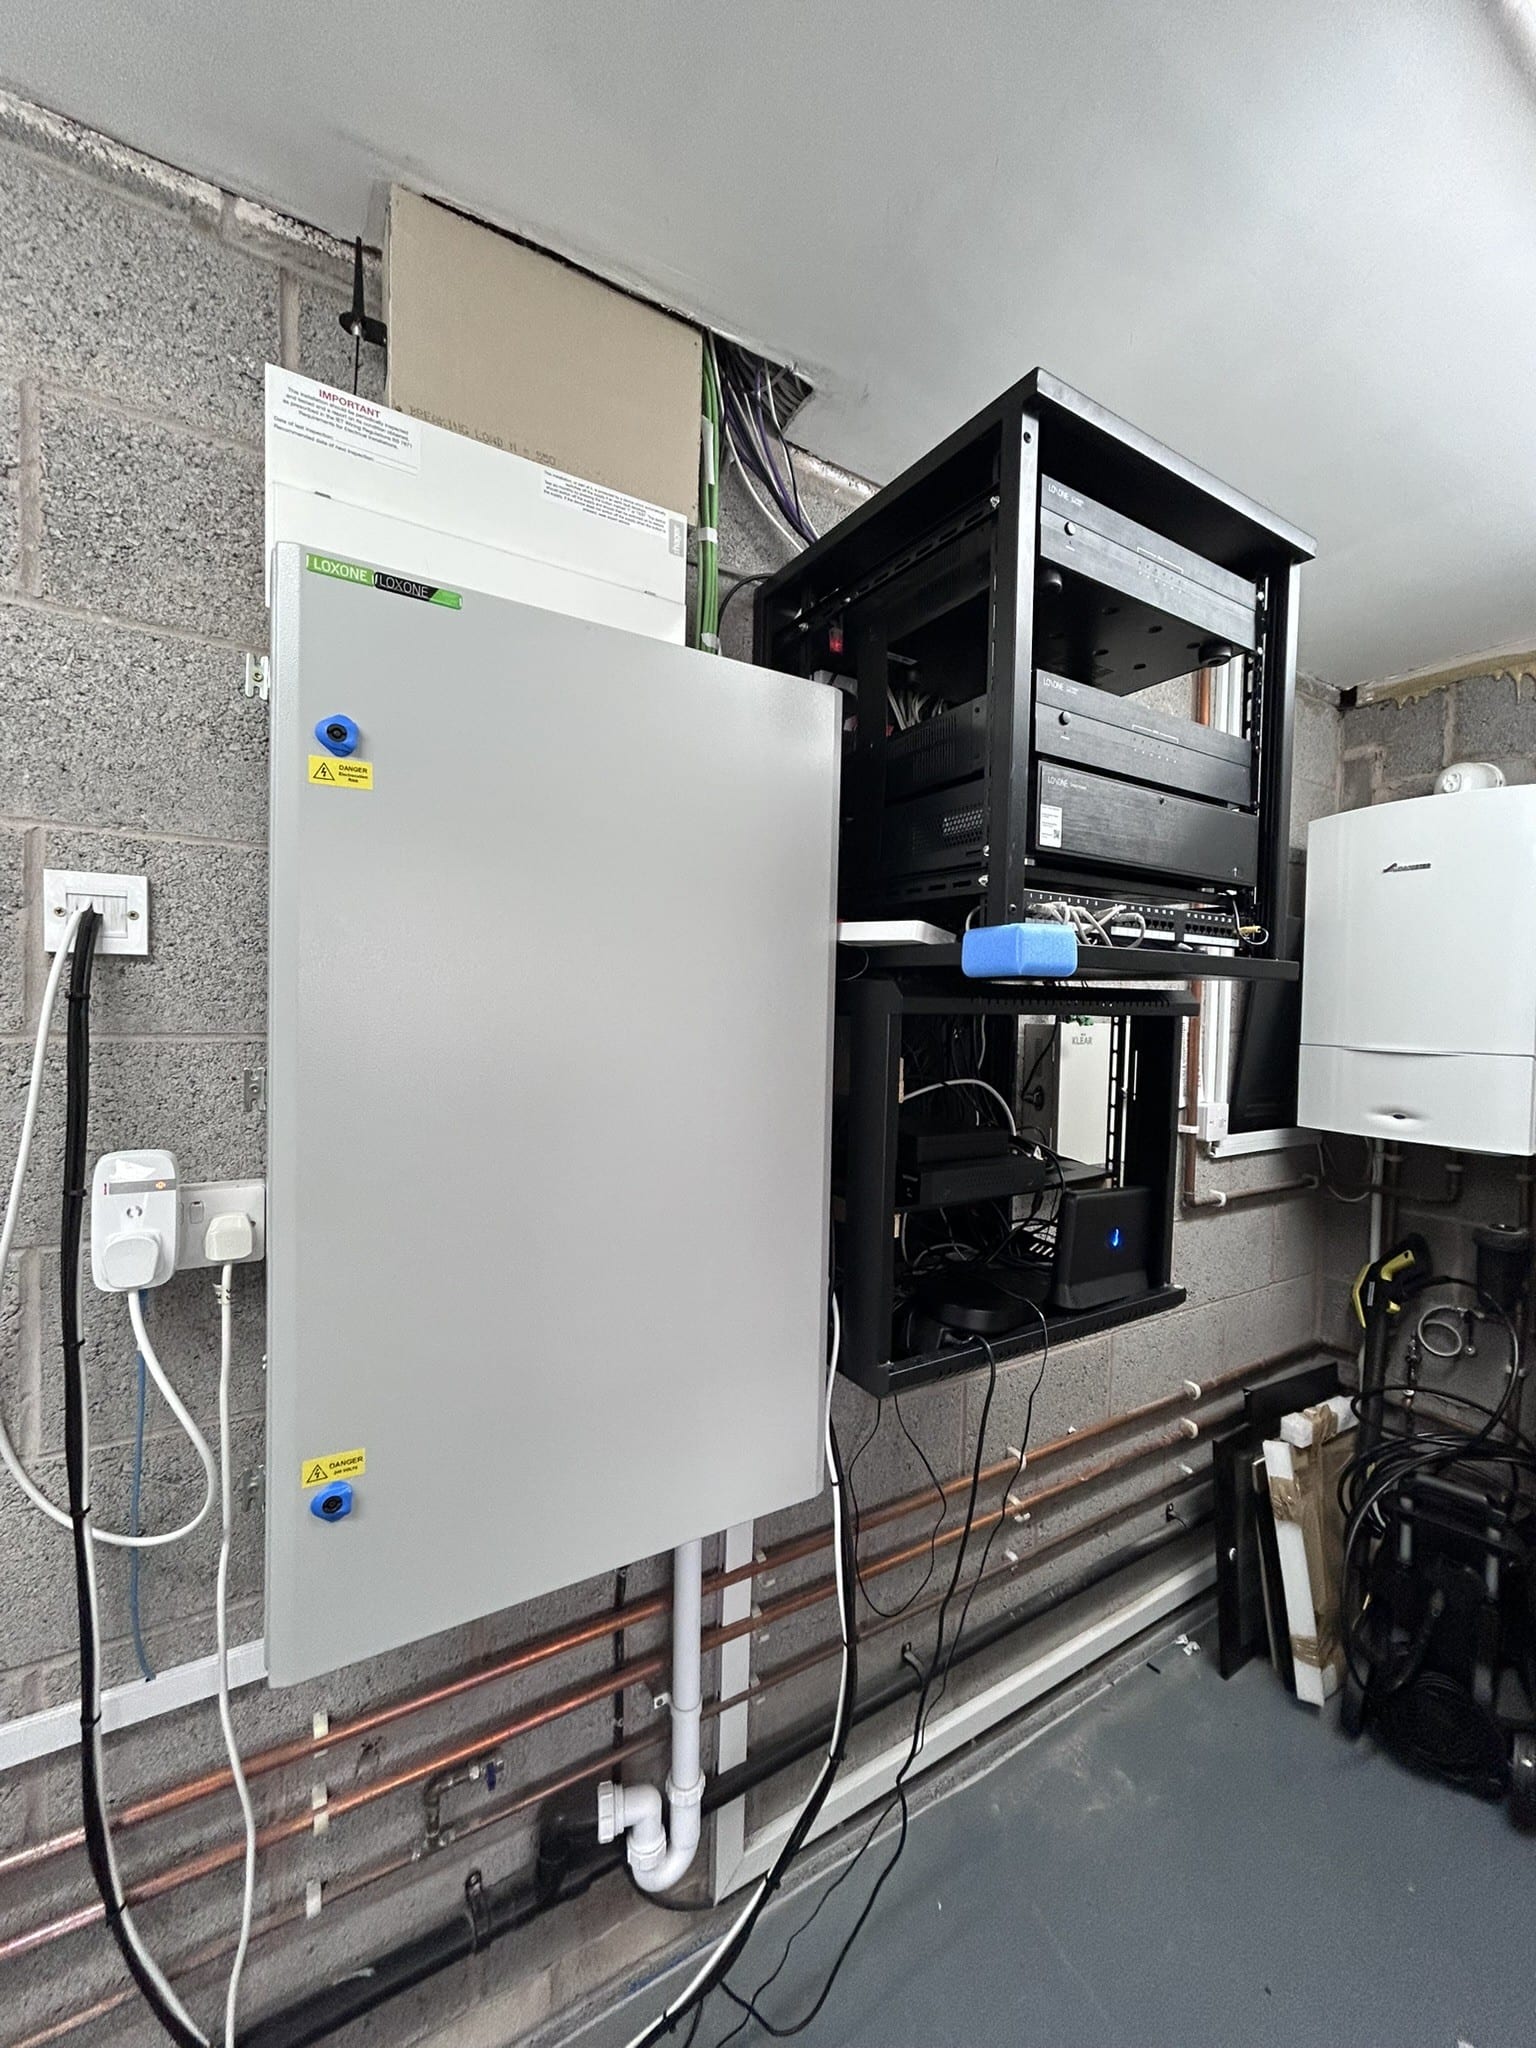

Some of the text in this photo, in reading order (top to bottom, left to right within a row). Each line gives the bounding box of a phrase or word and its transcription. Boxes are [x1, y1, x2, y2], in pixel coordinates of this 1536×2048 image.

[319, 389, 380, 418] IMPORTANT
[313, 557, 368, 582] LOXONE
[379, 575, 429, 599] LOXONE
[338, 764, 368, 774] DANGER
[329, 1456, 363, 1469] DANGER
